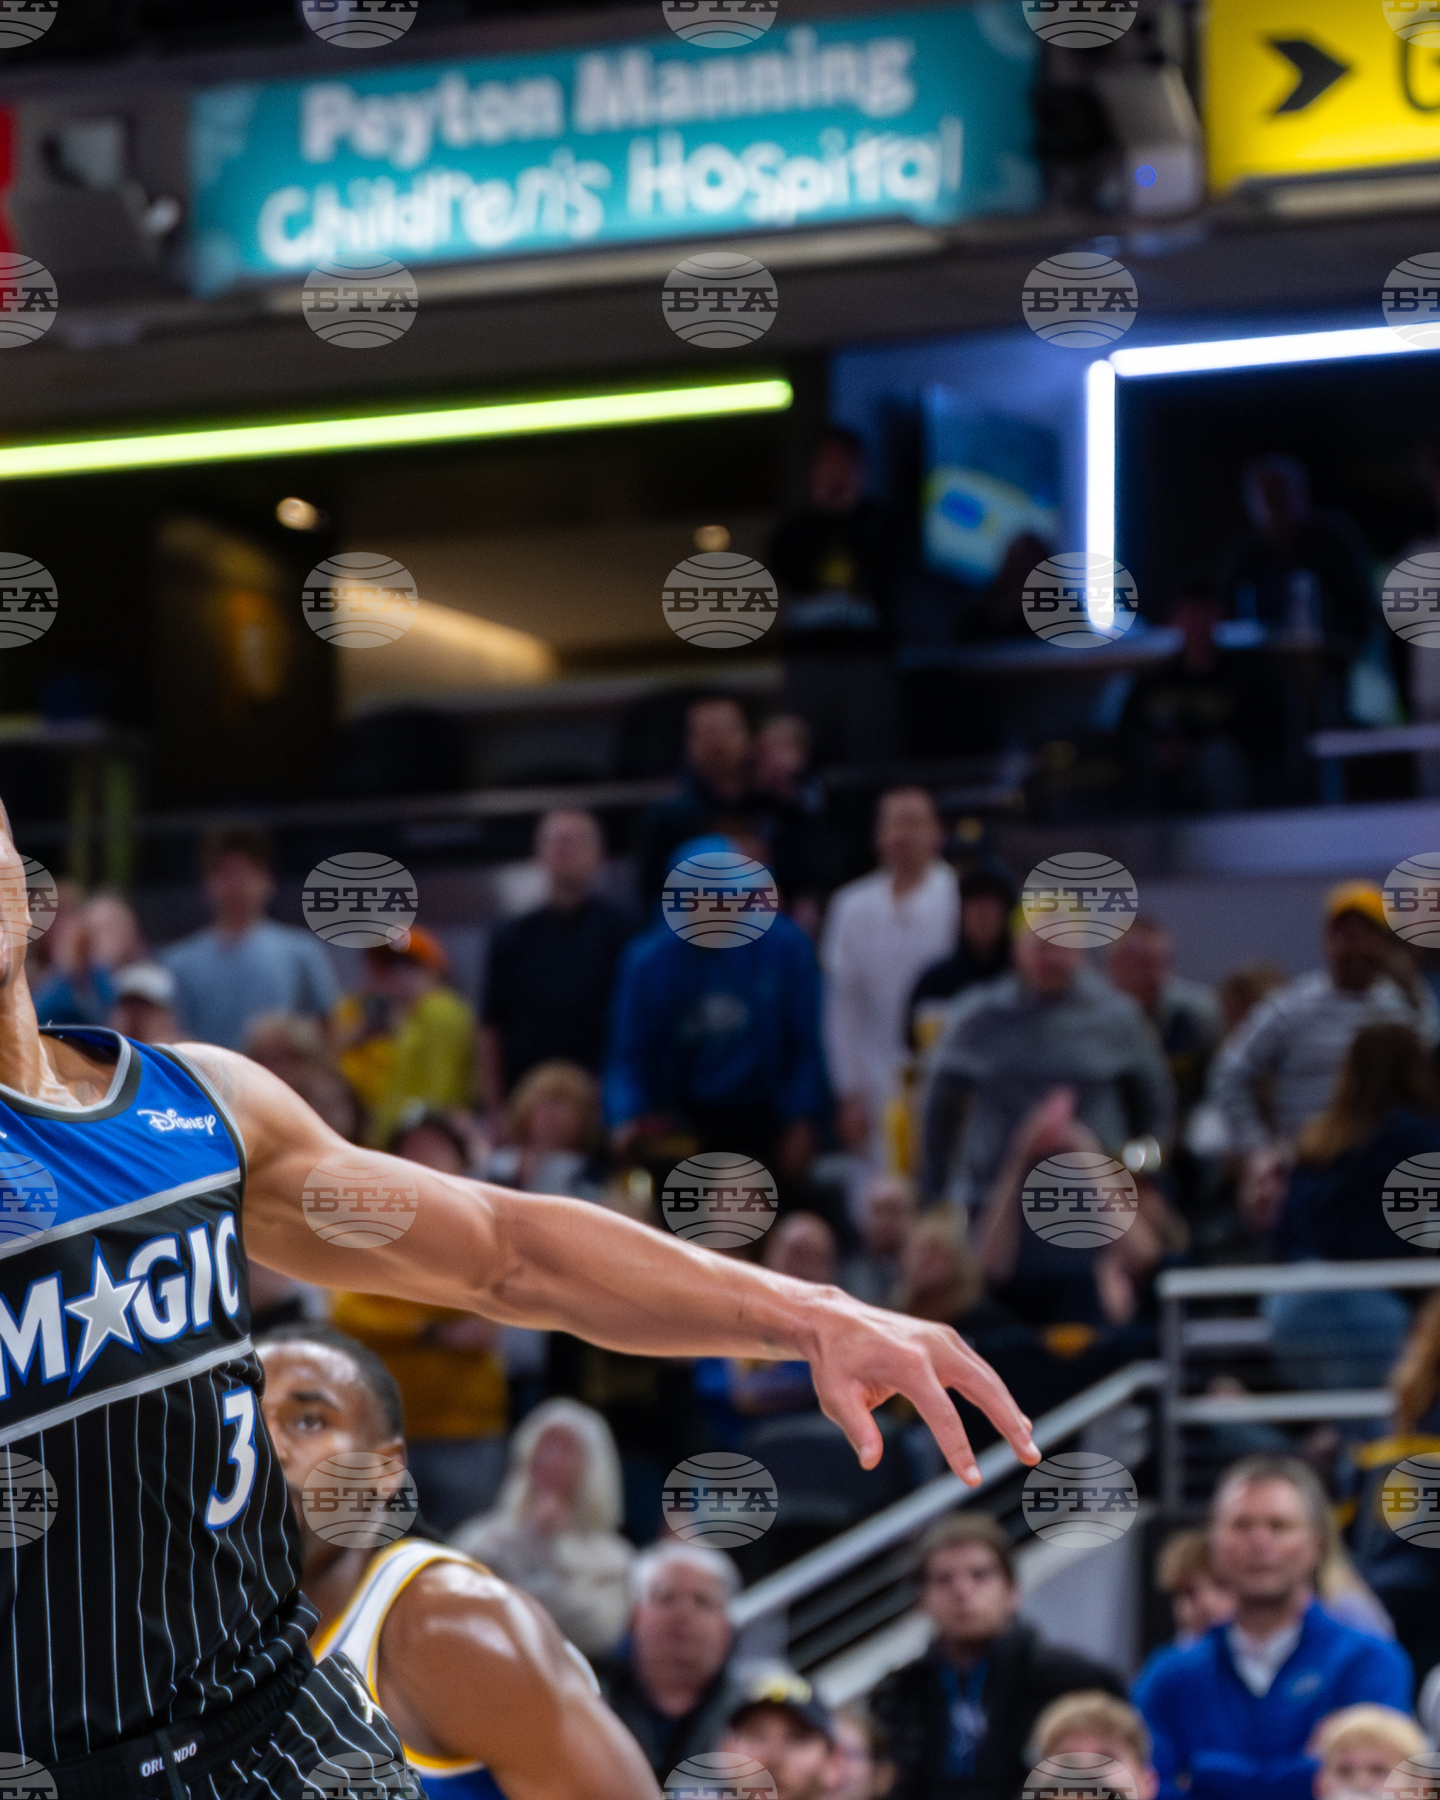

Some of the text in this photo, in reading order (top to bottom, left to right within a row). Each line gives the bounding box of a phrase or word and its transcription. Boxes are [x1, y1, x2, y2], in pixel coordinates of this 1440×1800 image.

[300, 26, 916, 169] Peyton Manning
[260, 114, 964, 266] Children's Hospital
[205, 1385, 259, 1531] 3
[141, 1741, 197, 1778] ORLNDO
